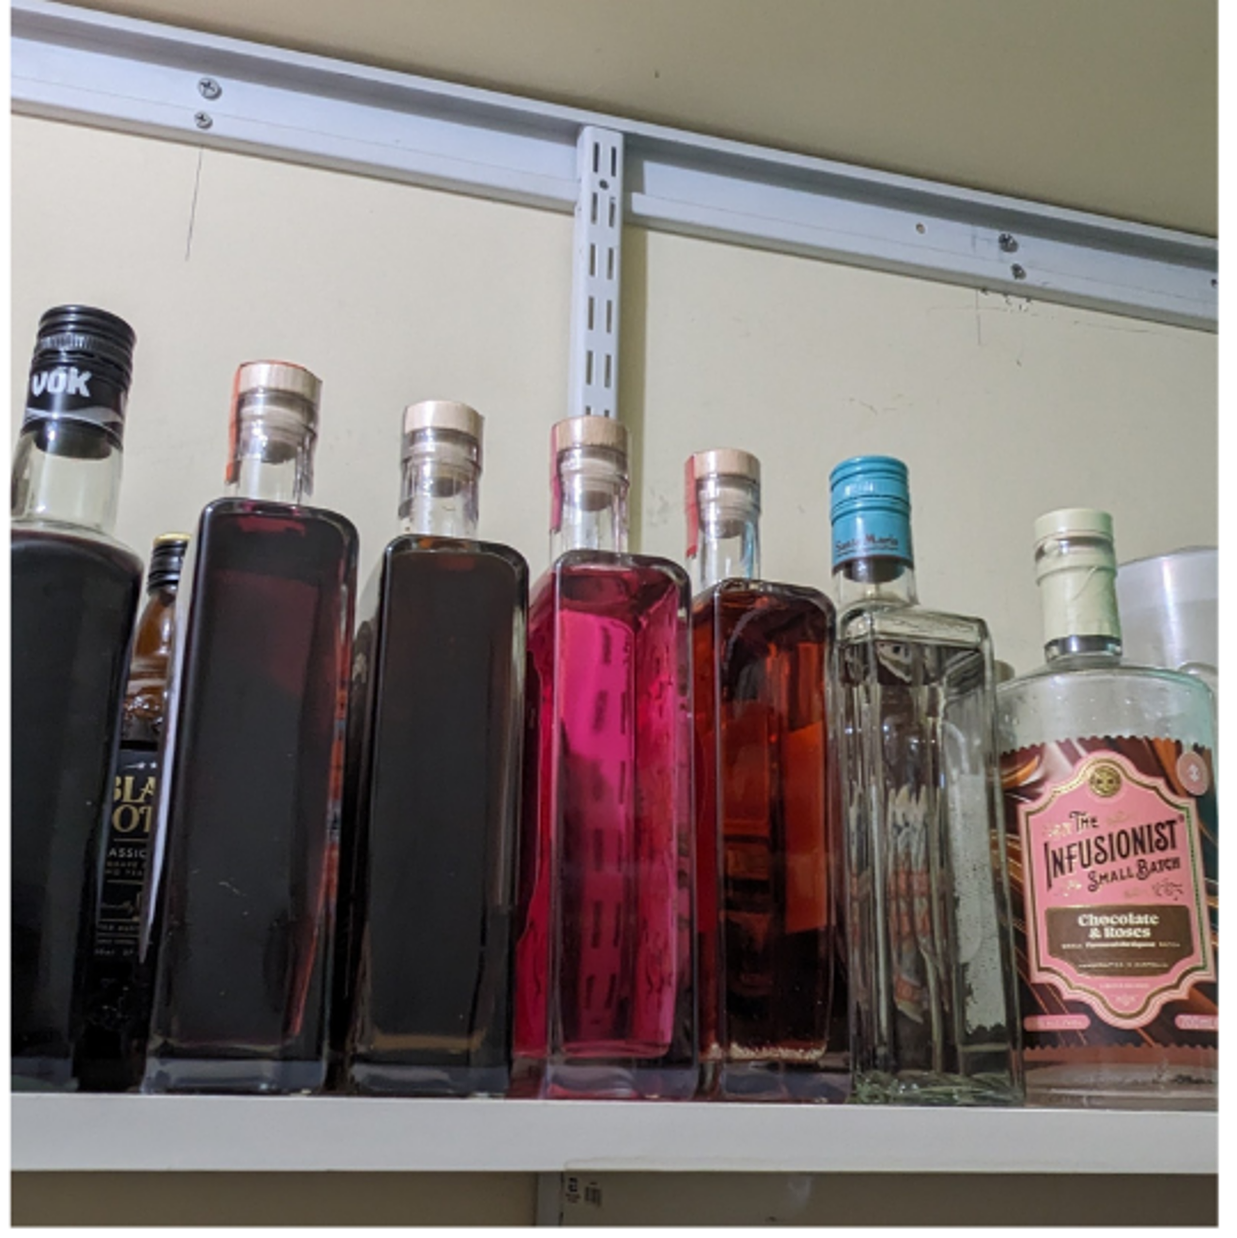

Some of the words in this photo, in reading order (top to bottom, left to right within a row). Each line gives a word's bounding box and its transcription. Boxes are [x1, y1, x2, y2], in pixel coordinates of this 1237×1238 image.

[1043, 819, 1178, 893] INFUSIONIST
[1077, 912, 1160, 927] Chocolate
[1103, 926, 1152, 939] Roses
